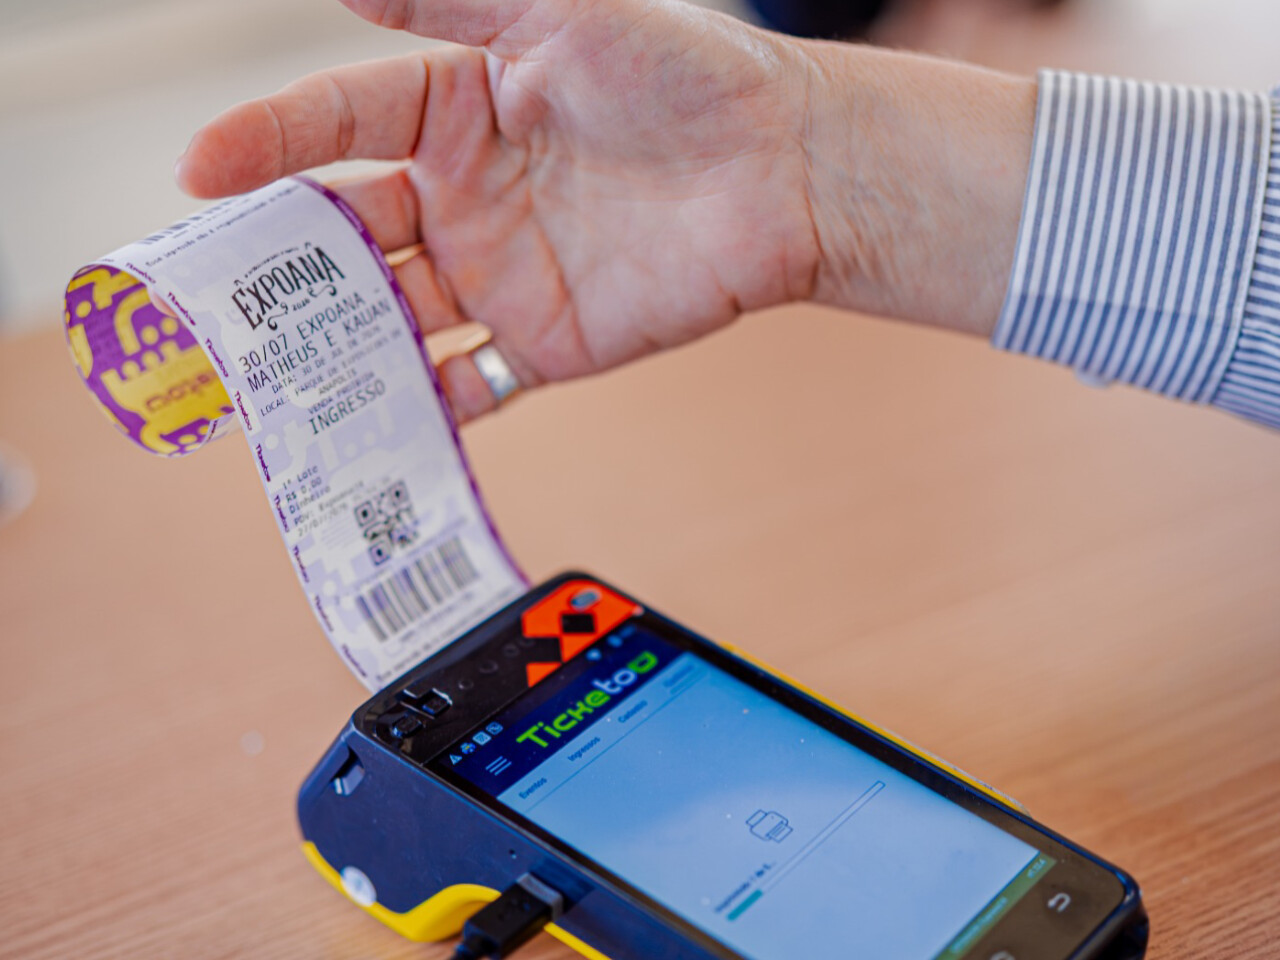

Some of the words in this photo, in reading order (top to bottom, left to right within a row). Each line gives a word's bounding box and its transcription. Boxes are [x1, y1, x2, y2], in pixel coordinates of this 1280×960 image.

[231, 246, 346, 330] EXPOANA
[239, 333, 287, 373] 30/07
[296, 292, 364, 340] EXPOANA
[245, 341, 318, 392] MATHEUS
[324, 330, 334, 347] E
[342, 302, 390, 336] KAUAN
[308, 380, 384, 434] INGRESSO
